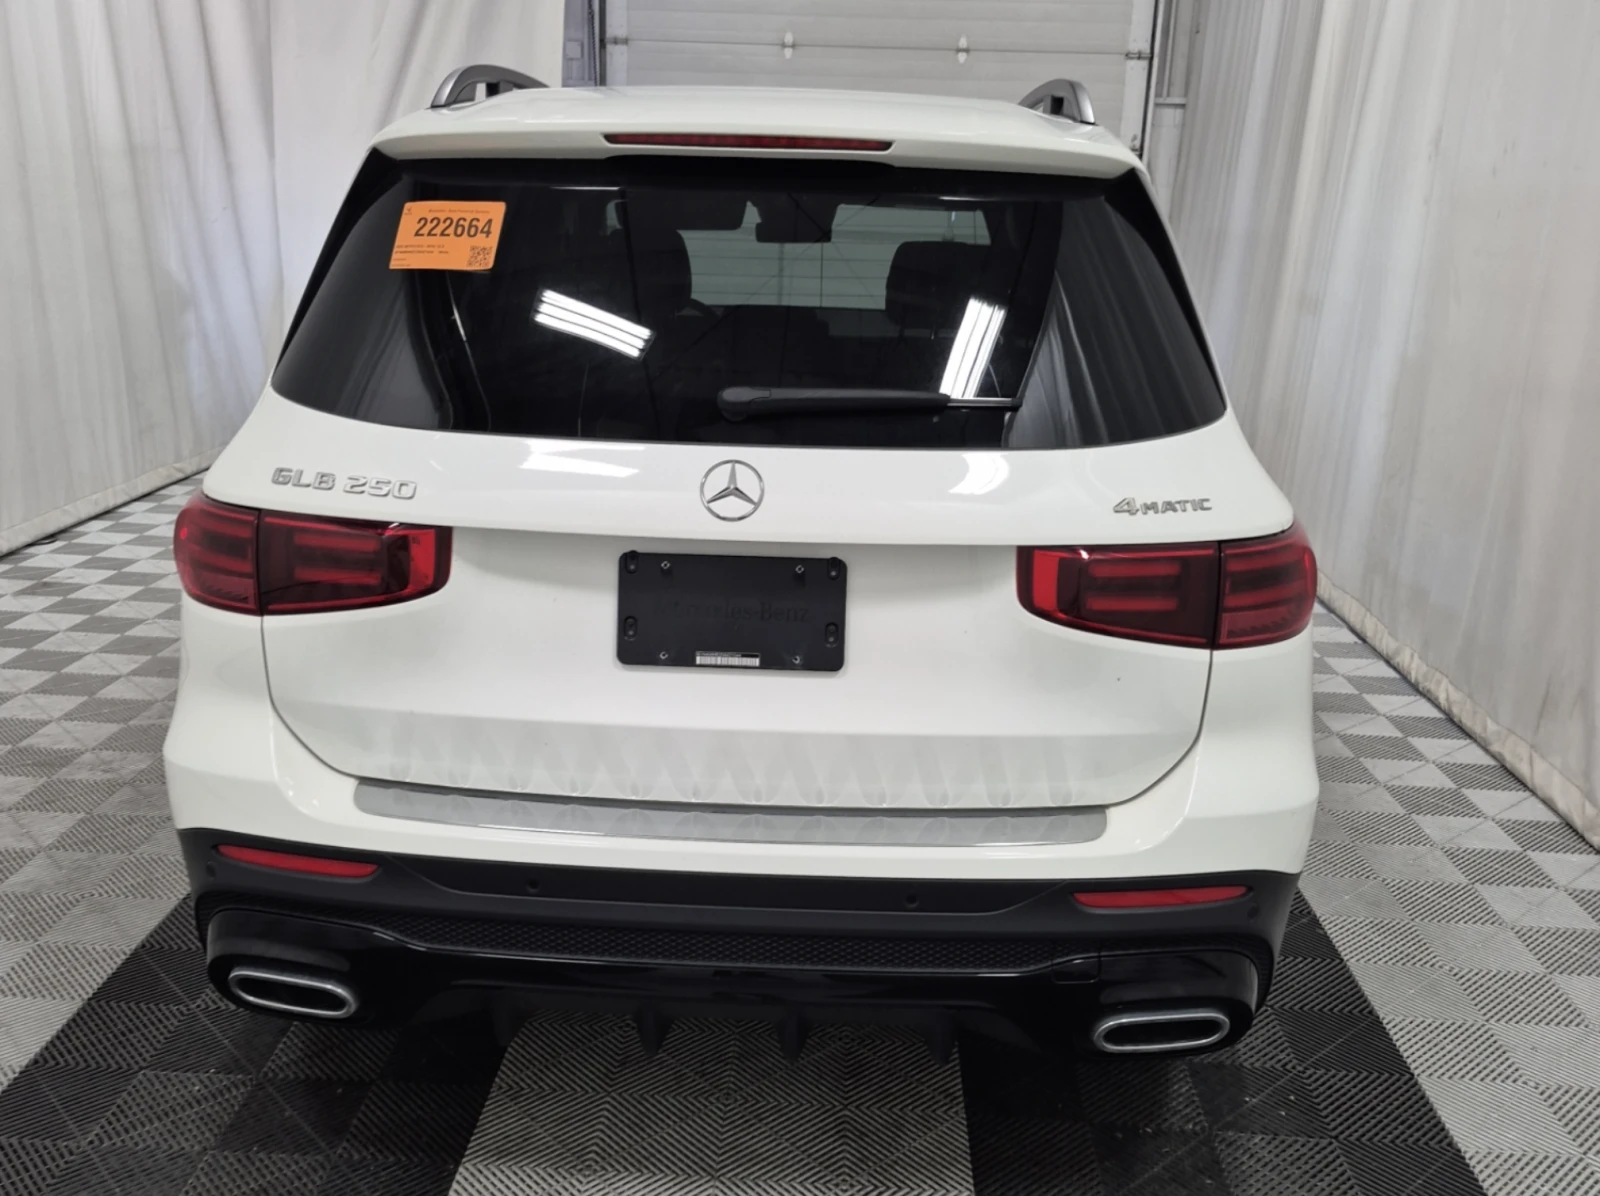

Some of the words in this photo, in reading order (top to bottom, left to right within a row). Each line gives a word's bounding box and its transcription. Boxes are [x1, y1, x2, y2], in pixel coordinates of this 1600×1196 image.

[413, 216, 493, 238] 222664
[271, 467, 336, 491] GLB
[343, 475, 417, 500] 250
[1113, 497, 1212, 516] 4MATIC
[653, 599, 809, 622] Meredes-Benz
